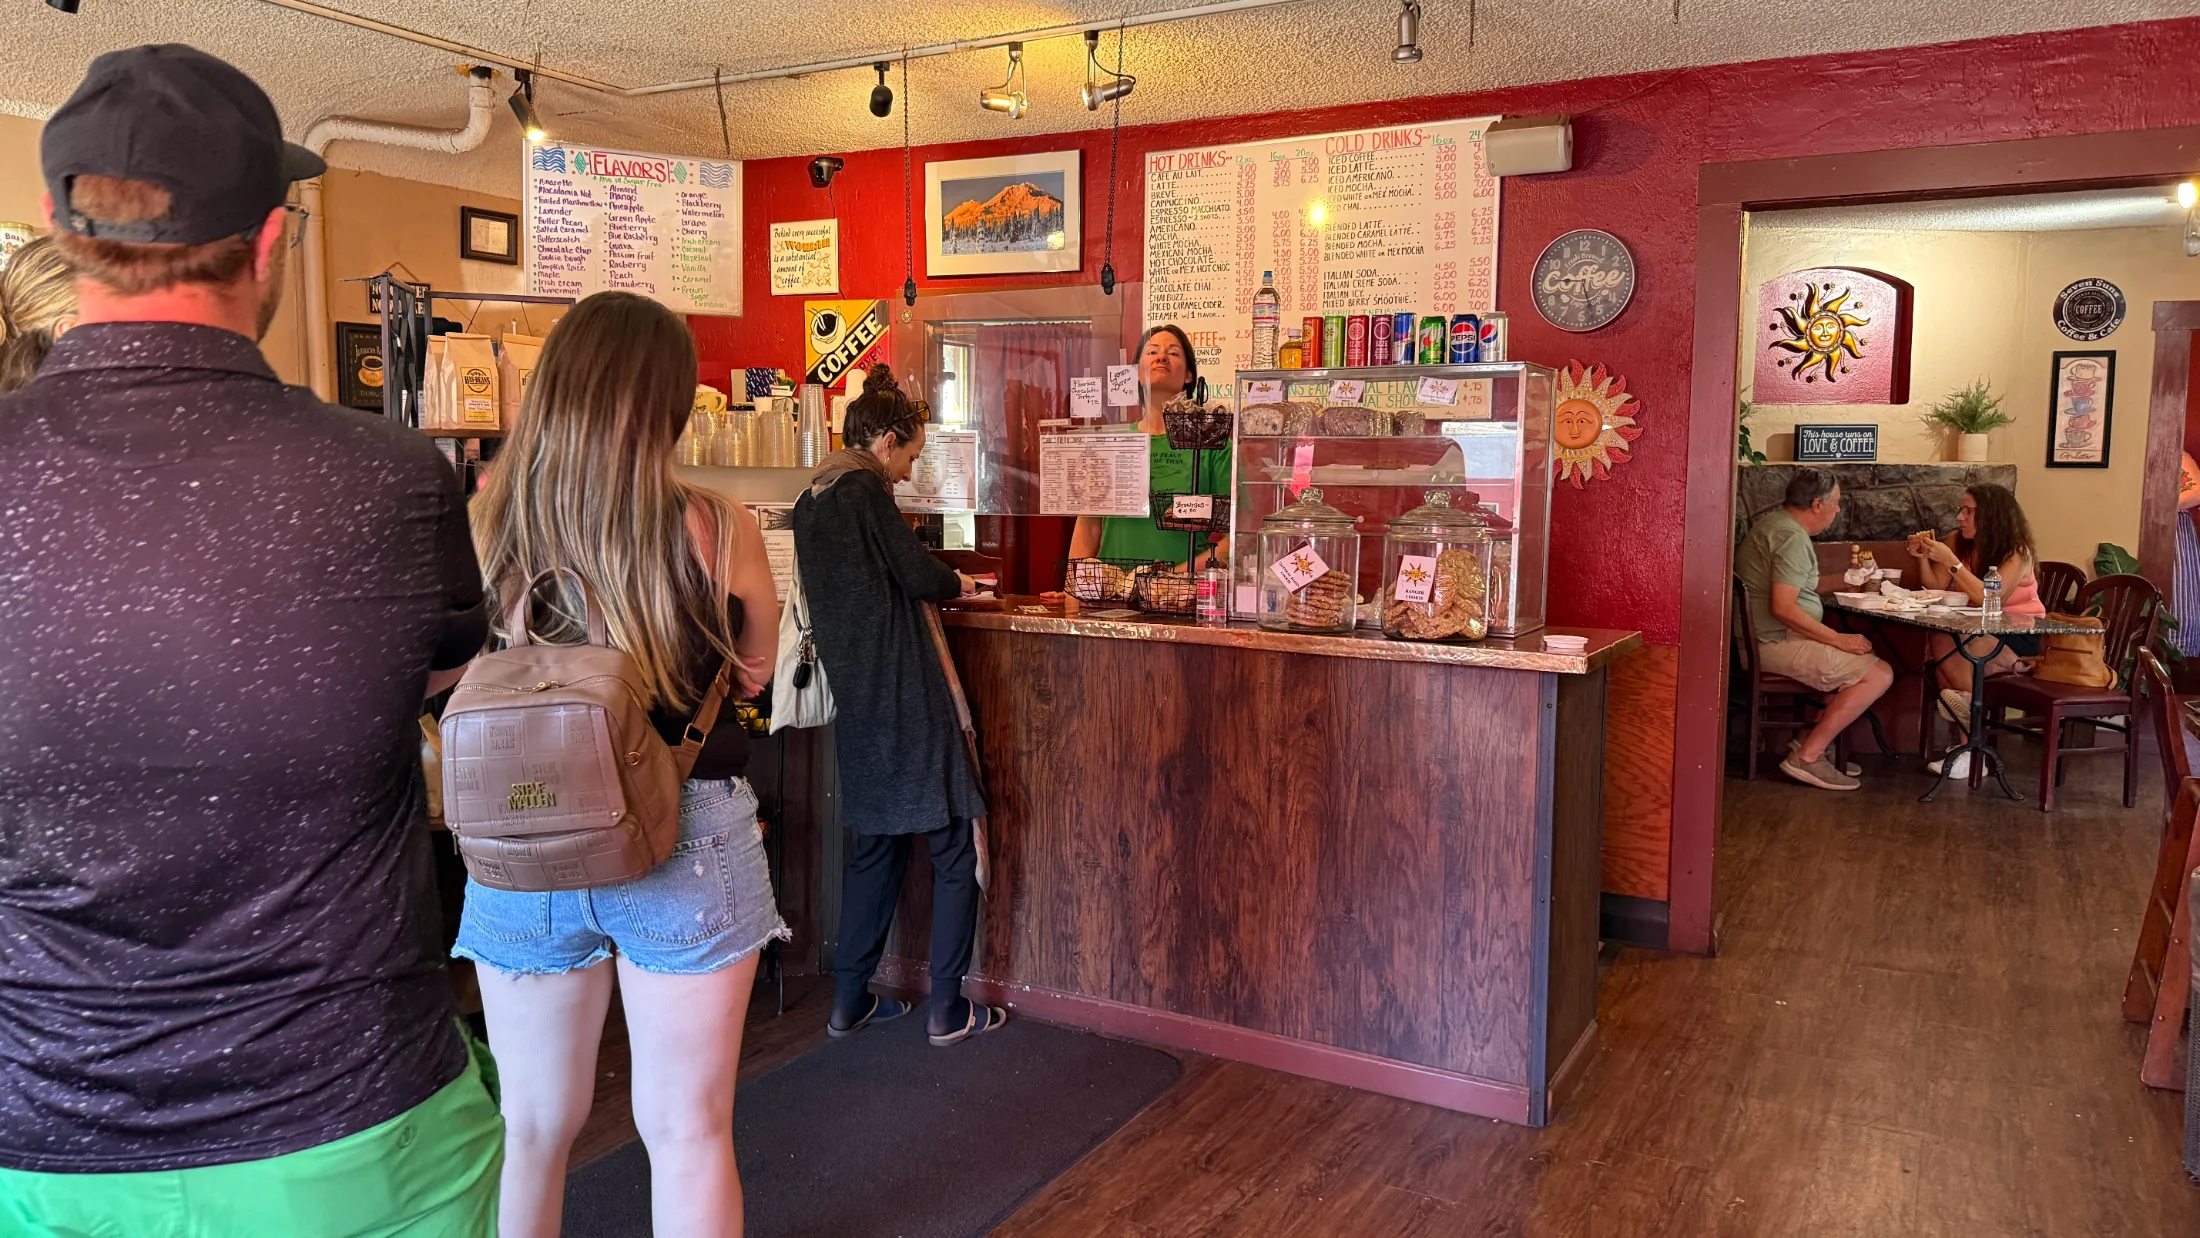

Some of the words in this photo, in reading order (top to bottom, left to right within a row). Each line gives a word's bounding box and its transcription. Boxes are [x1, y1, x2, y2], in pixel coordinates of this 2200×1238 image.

[1325, 133, 1364, 155] COLD
[1436, 144, 1457, 154] 3.50
[1328, 155, 1347, 165] ICED
[1436, 153, 1457, 163] 5.00
[593, 153, 667, 183] FLAVORS
[1149, 155, 1175, 173] HOT
[1300, 165, 1320, 175] 5.50
[1172, 171, 1183, 180] AU
[1300, 174, 1319, 184] 6.25
[1328, 175, 1345, 185] ICED
[1474, 178, 1495, 188] 7.00
[580, 189, 592, 198] Nut
[609, 184, 638, 195] Almond
[1327, 185, 1344, 194] ICED
[1473, 187, 1495, 198] 6.00
[538, 206, 573, 216] Lavender
[1150, 206, 1189, 217] ESPRESSO
[537, 216, 560, 225] Butter
[608, 212, 634, 222] Green
[635, 214, 657, 224] Apple
[559, 225, 589, 234] Caramel
[608, 223, 648, 236] Blueberry
[681, 227, 708, 240] Cherry
[537, 234, 581, 243] Butterscotch
[607, 231, 622, 240] Blue
[1324, 232, 1356, 241] BLENDED
[1357, 230, 1388, 239] CARAMEL
[537, 244, 573, 254] Chocolate
[575, 246, 592, 255] Chip
[1148, 241, 1171, 250] WHITE
[1324, 242, 1355, 251] BLENDED
[1435, 240, 1456, 250] 6.25
[1579, 240, 1591, 251] 12
[538, 253, 562, 261] Cookie
[680, 253, 712, 262] Hazelnut
[1149, 249, 1184, 258] MEXICAN
[1323, 250, 1355, 261] BLENDED
[1355, 249, 1376, 259] WHITE
[1401, 246, 1425, 256] MOCHA
[1563, 247, 1571, 258] 11
[681, 263, 707, 272] Vanilla
[1149, 258, 1166, 268] HOT
[1549, 259, 1561, 270] 10
[1612, 255, 1620, 267] 2
[609, 270, 633, 280] Peach
[1299, 266, 1319, 275] 5.50
[1323, 270, 1353, 280] ITALIAN
[538, 278, 556, 287] Irish
[682, 274, 712, 283] Caramel
[1468, 278, 1489, 287] 6.25
[1542, 264, 1626, 295] Coffee
[608, 280, 656, 294] Strawberry
[1149, 282, 1191, 293] CHOCOLATE
[1323, 280, 1350, 290] ITALIAN
[1352, 278, 1375, 288] CREME
[538, 286, 581, 295] Peppermint
[1468, 288, 1489, 299] 7.00
[2060, 280, 2093, 300] Seven
[2095, 279, 2120, 298] Suns
[1322, 299, 1345, 308] MIXED
[1347, 297, 1370, 307] BERRY
[1548, 294, 1556, 306] 8
[1608, 291, 1617, 304] 4
[1560, 305, 1569, 317] 7
[1595, 304, 1604, 315] 5
[2075, 304, 2103, 314] COFFEE
[1578, 310, 1586, 322] 6
[2057, 319, 2086, 340] Coffee
[817, 313, 883, 383] COFFEE
[1803, 429, 1820, 438] This
[1821, 429, 1844, 438] house
[1803, 438, 1828, 453] LOVE
[1830, 438, 1838, 453] &
[1840, 438, 1874, 453] COFFEE
[511, 781, 546, 796] STEVE
